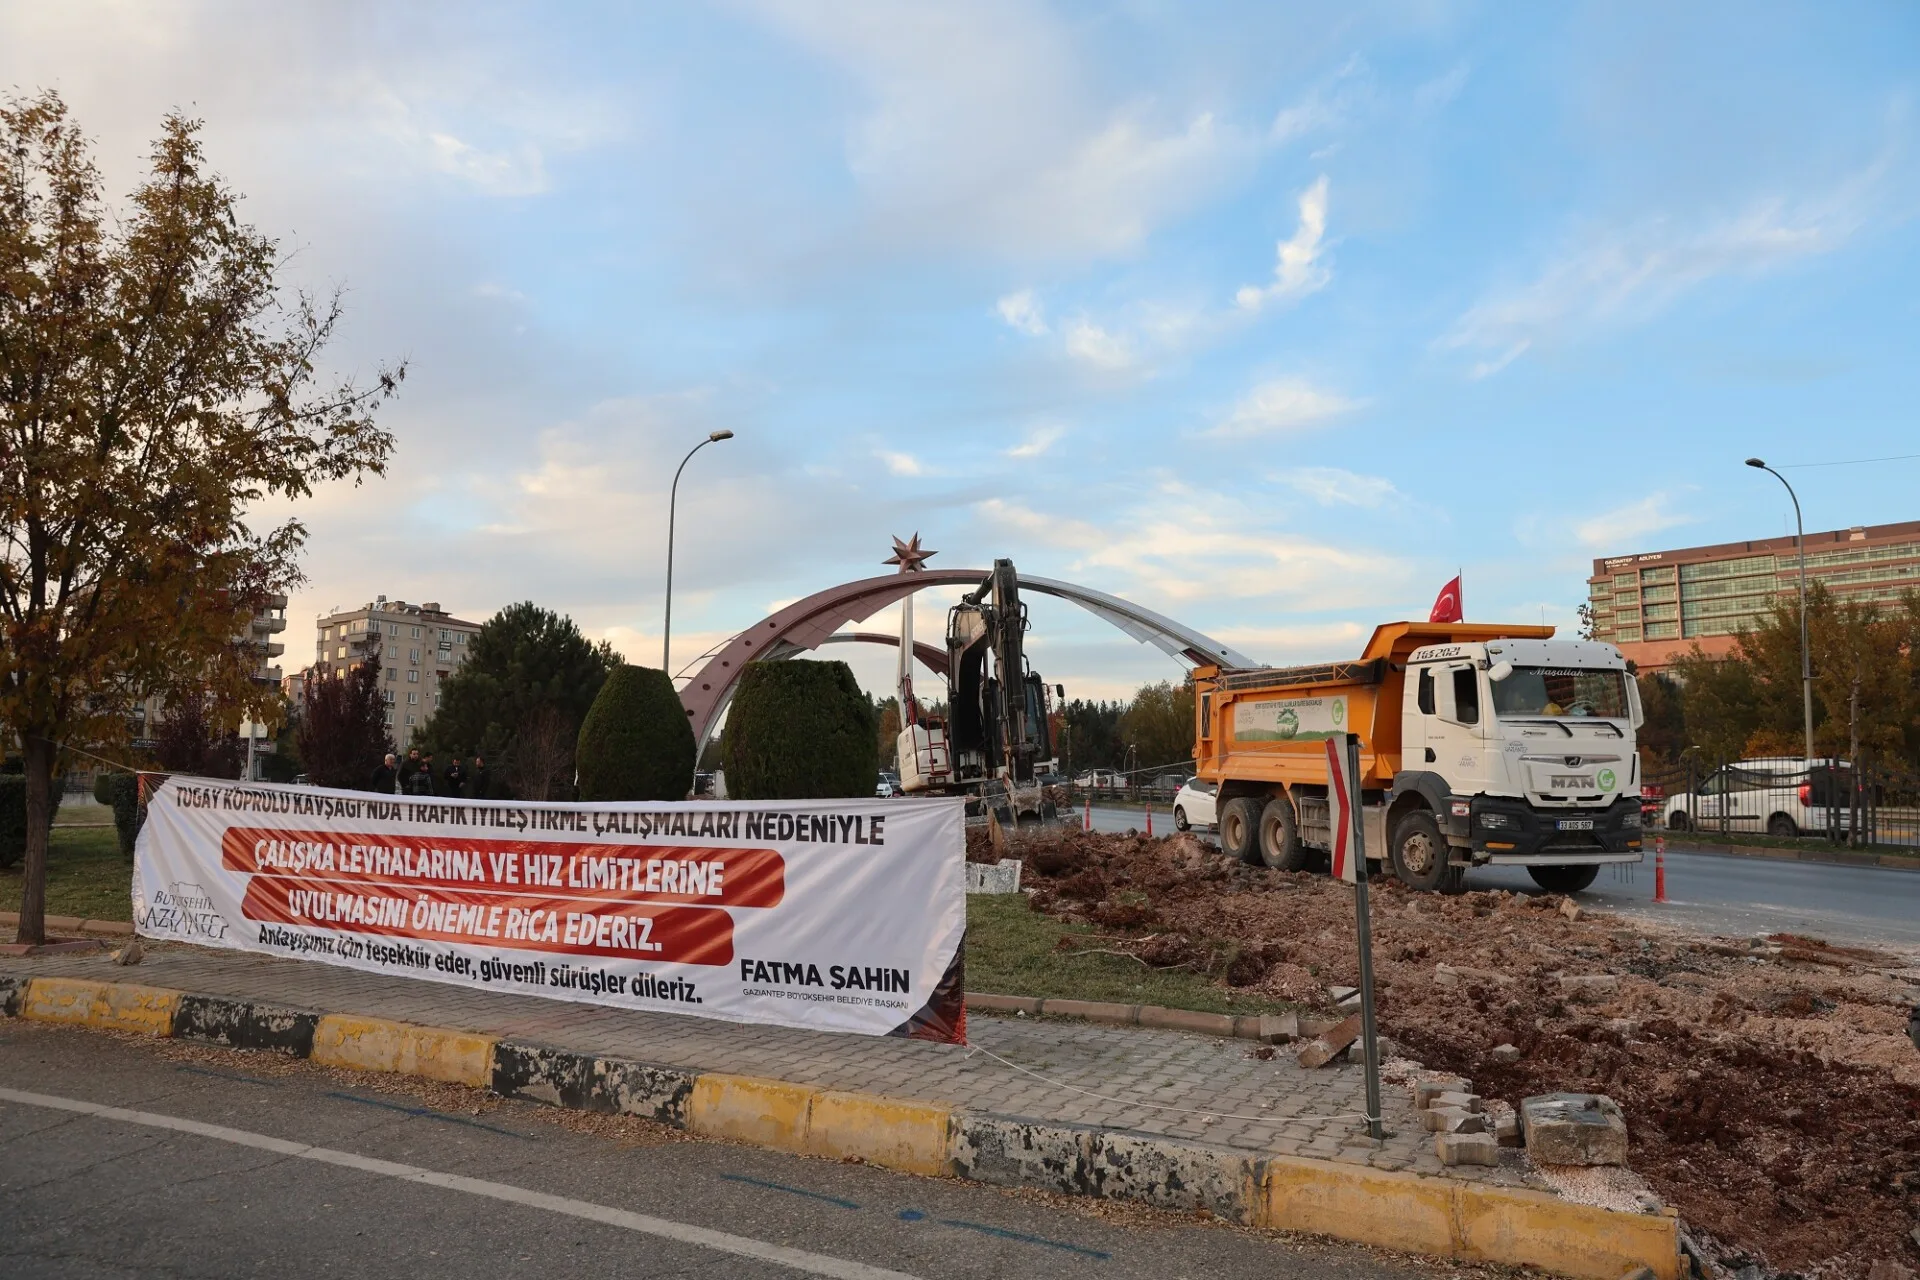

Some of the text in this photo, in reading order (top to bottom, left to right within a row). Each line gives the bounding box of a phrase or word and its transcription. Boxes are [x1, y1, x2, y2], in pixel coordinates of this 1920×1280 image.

[1416, 646, 1461, 660] TGS 2021
[1551, 777, 1595, 789] MAN
[176, 786, 222, 809] TUGAY
[592, 810, 740, 839] ÇALIŞMALARI
[745, 813, 885, 845] NEDENİYLE
[254, 839, 725, 896] ÇALIŞMA LEVHALARINA VE HIZ LİMİTLERİNE
[288, 889, 662, 952] UYULMASINI ÖNEMLE RİCA EDERİZ.
[258, 924, 703, 1004] Anlayışınız için teşekkür eder, güvenli sürüşler dileriz.
[740, 958, 910, 994] FATMA ŞAHİN
